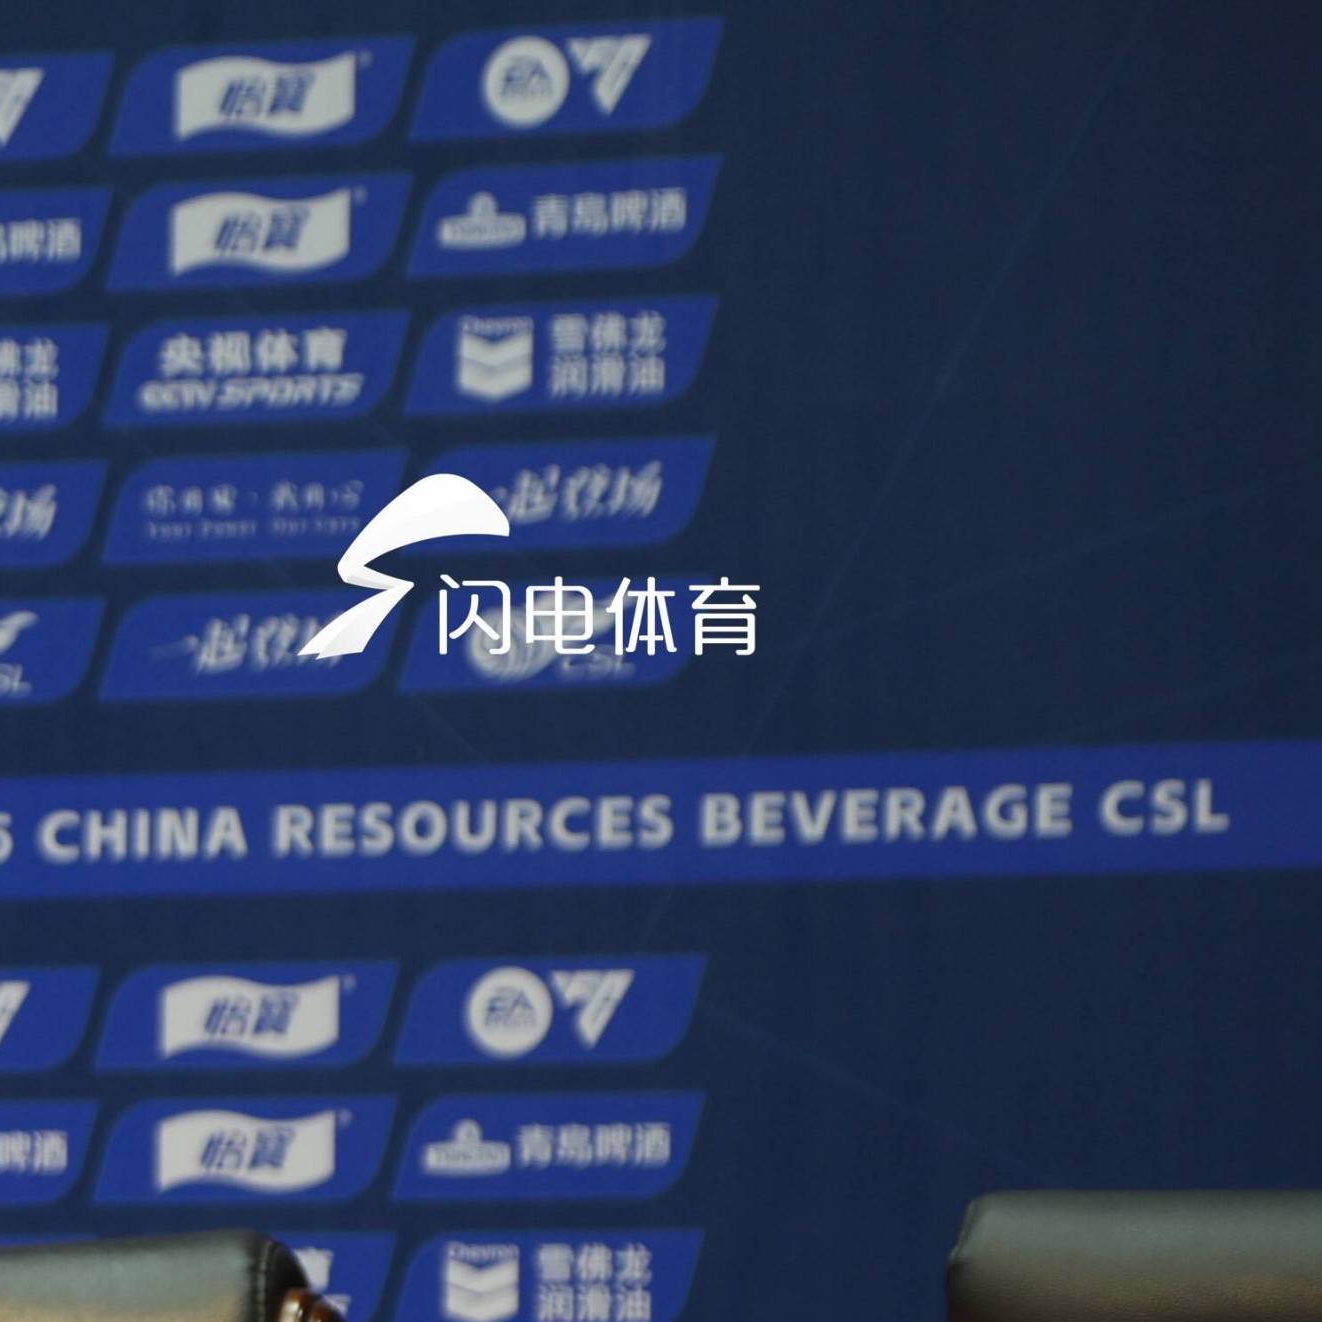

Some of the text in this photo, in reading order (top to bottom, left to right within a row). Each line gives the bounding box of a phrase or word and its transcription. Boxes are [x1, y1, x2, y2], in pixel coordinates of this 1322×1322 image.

[39, 807, 247, 861] CHINA
[274, 795, 672, 855] RESOURCES
[701, 784, 1071, 844] BEVERAGE
[1101, 780, 1228, 833] CSL
